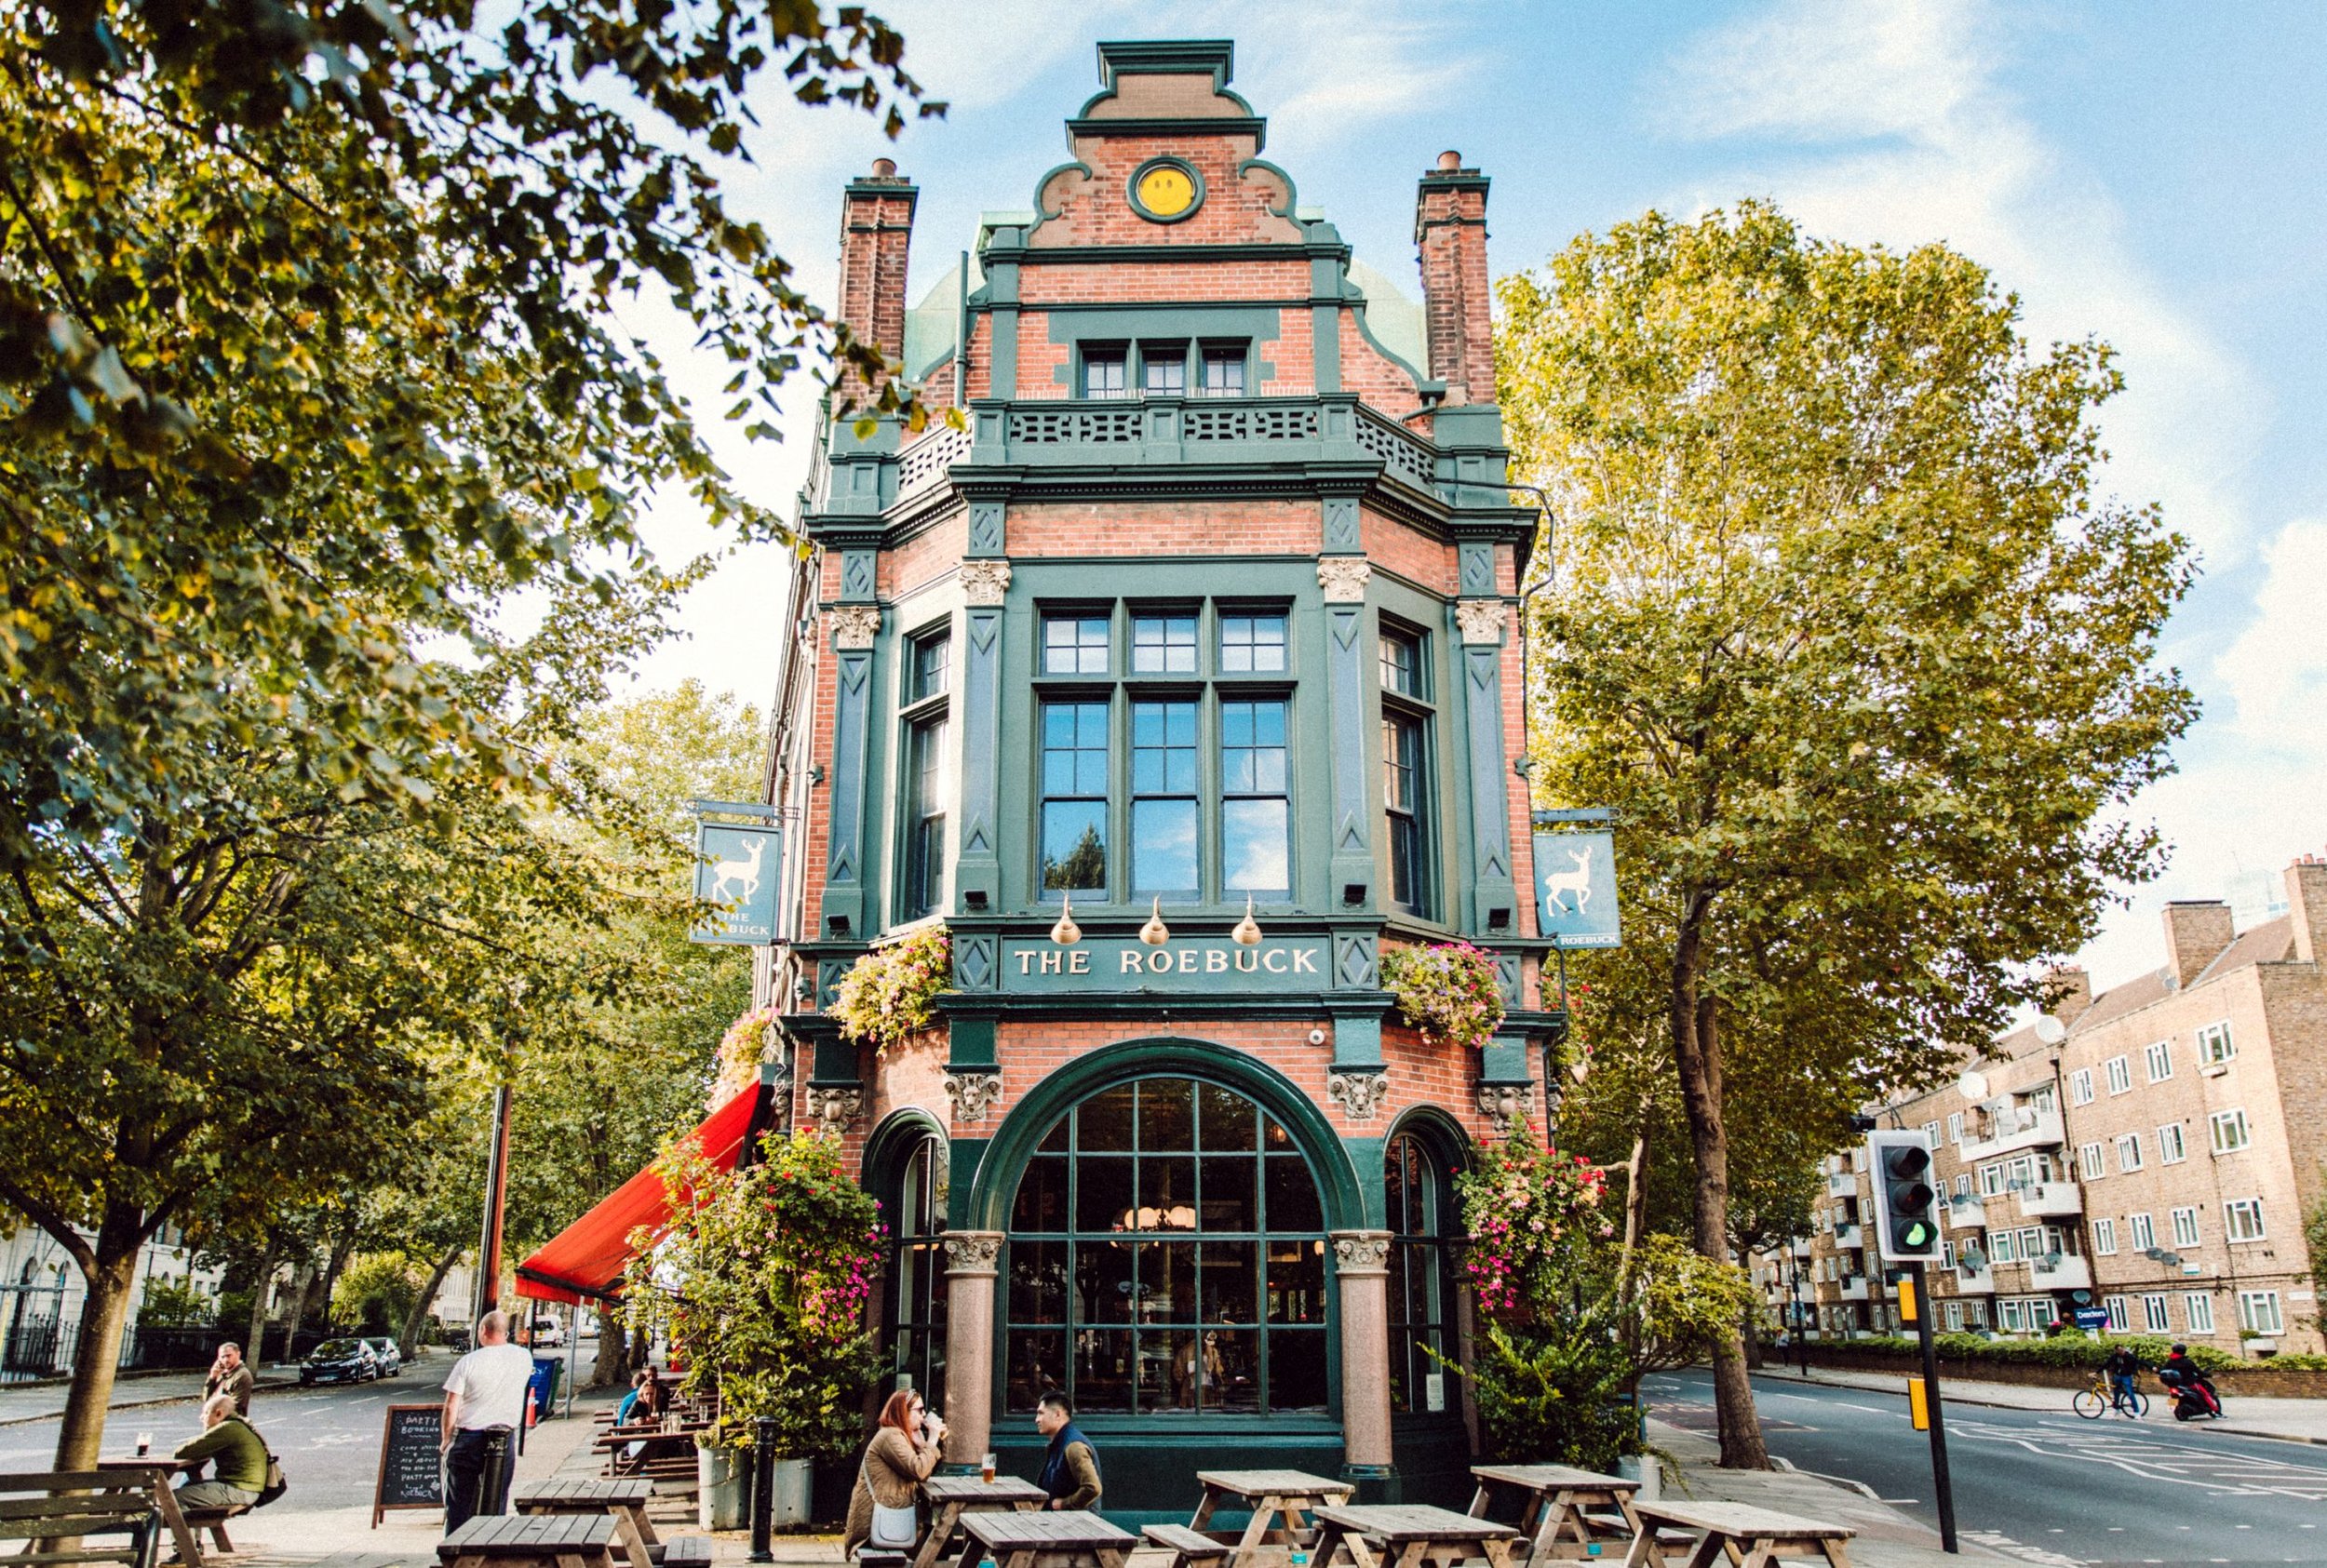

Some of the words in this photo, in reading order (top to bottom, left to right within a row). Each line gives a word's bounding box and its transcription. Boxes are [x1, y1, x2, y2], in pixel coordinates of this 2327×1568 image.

[1560, 935, 1618, 945] ROEBUCK
[1014, 950, 1091, 975] THE
[1120, 948, 1319, 974] ROEBUCK
[406, 1416, 437, 1426] PARTY
